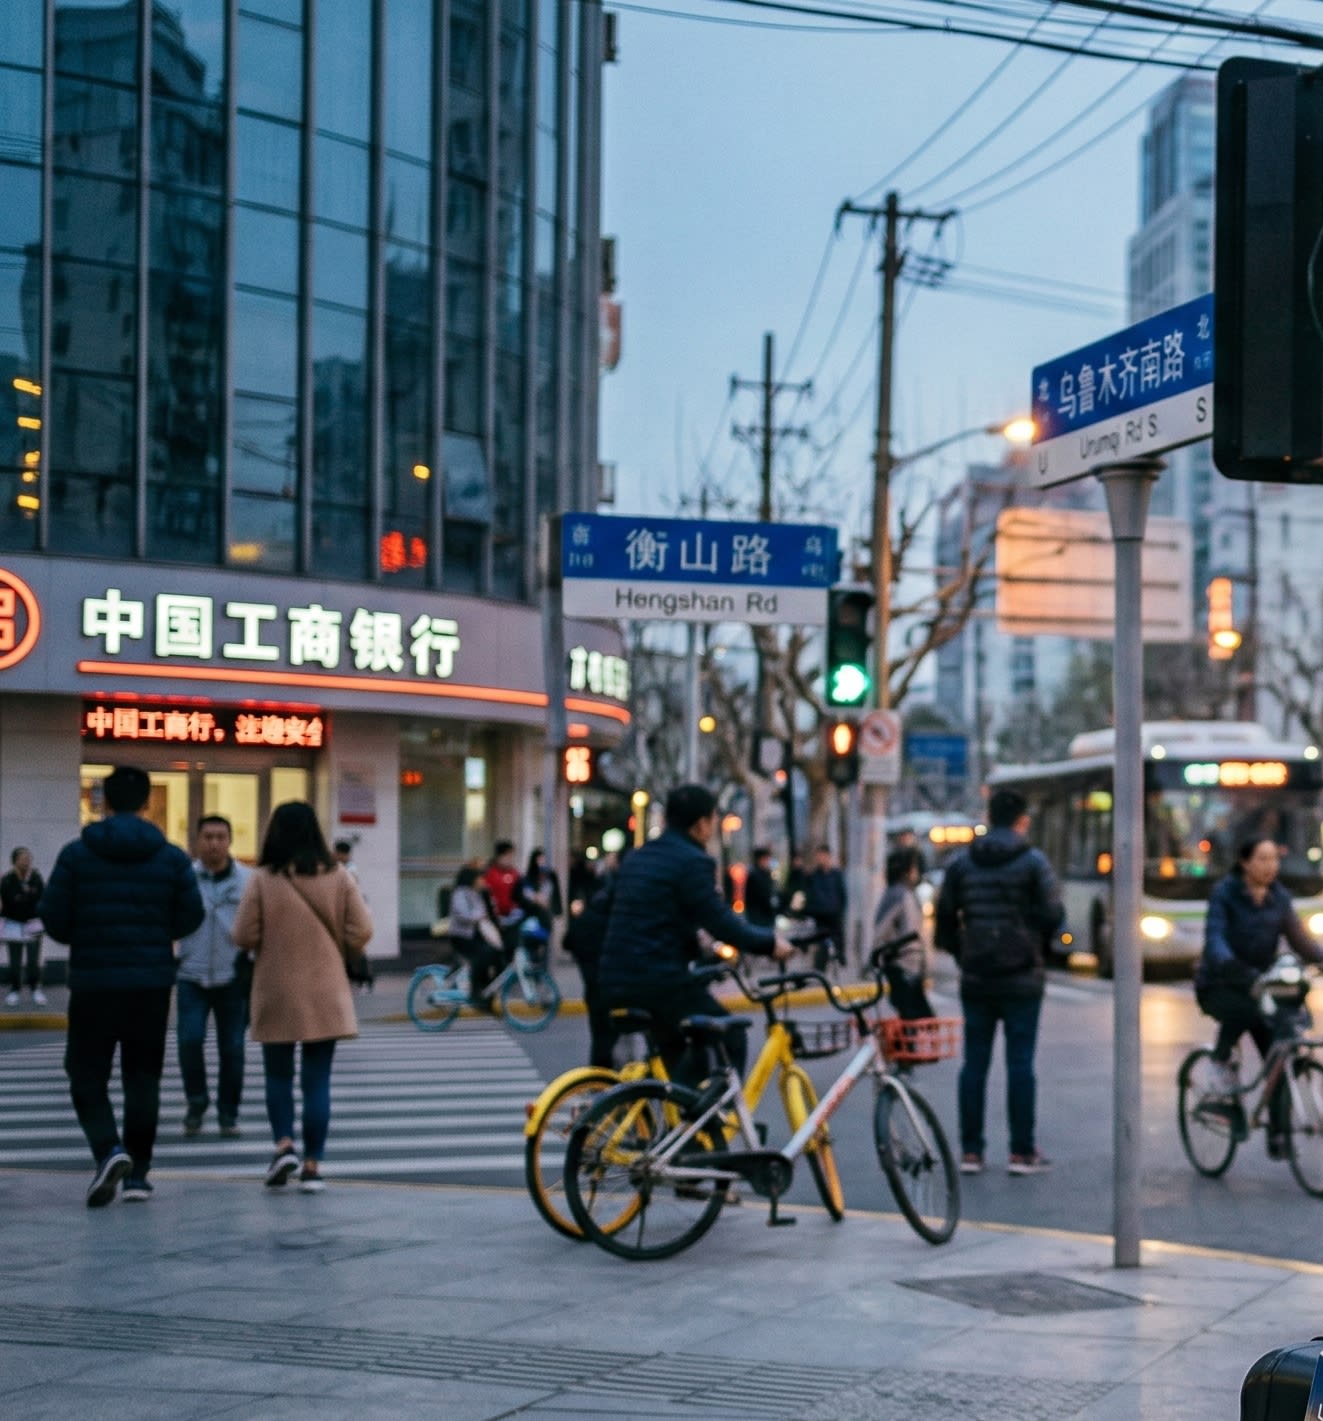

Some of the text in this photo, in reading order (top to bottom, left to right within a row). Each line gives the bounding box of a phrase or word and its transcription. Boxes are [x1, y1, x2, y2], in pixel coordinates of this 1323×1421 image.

[1057, 329, 1186, 420] 乌鲁木齐南路
[1147, 413, 1158, 438] S
[625, 527, 773, 577] 衡山路
[615, 588, 778, 616] Hengshan Rd
[82, 588, 462, 679] 中国工商银行
